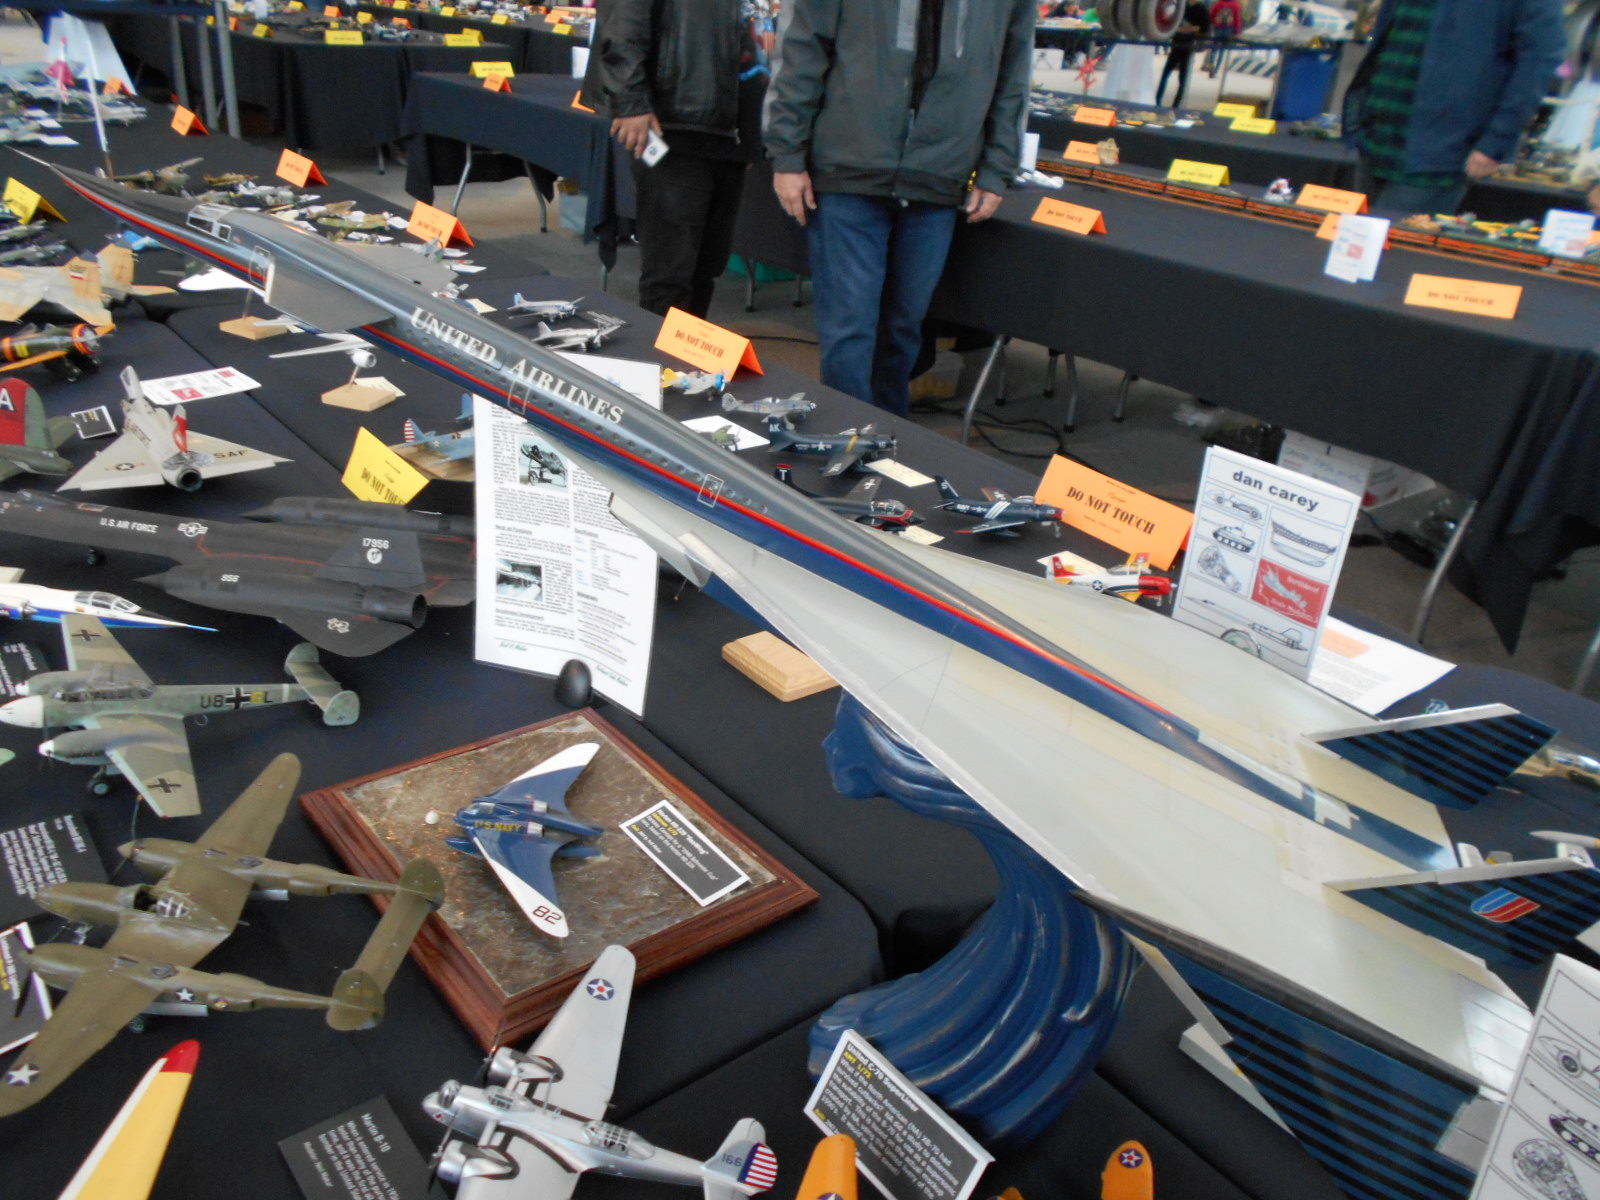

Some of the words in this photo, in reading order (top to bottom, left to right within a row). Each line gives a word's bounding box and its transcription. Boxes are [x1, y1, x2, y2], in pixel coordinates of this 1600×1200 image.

[675, 329, 686, 341] DO
[686, 334, 700, 347] NOT
[700, 341, 724, 358] TOUCH
[411, 307, 497, 364] UNITED
[510, 359, 624, 424] AIRLINES
[0, 388, 15, 411] A
[769, 423, 780, 432] AK
[214, 450, 248, 459] SAF
[361, 467, 372, 482] DO
[371, 475, 386, 496] NOT
[384, 487, 405, 504] TOU
[780, 469, 787, 480] T
[1233, 470, 1263, 491] dan
[1269, 483, 1319, 512] carey
[1066, 486, 1085, 502] DO
[1085, 494, 1111, 514] NOT
[1112, 506, 1156, 535] TOUCH
[116, 520, 130, 530] AIR
[131, 522, 158, 533] FORCE
[532, 905, 562, 925] 82
[846, 1044, 868, 1065] United
[360, 1113, 380, 1136] Martin
[373, 1134, 390, 1153] B-10
[722, 1153, 742, 1167] 166
